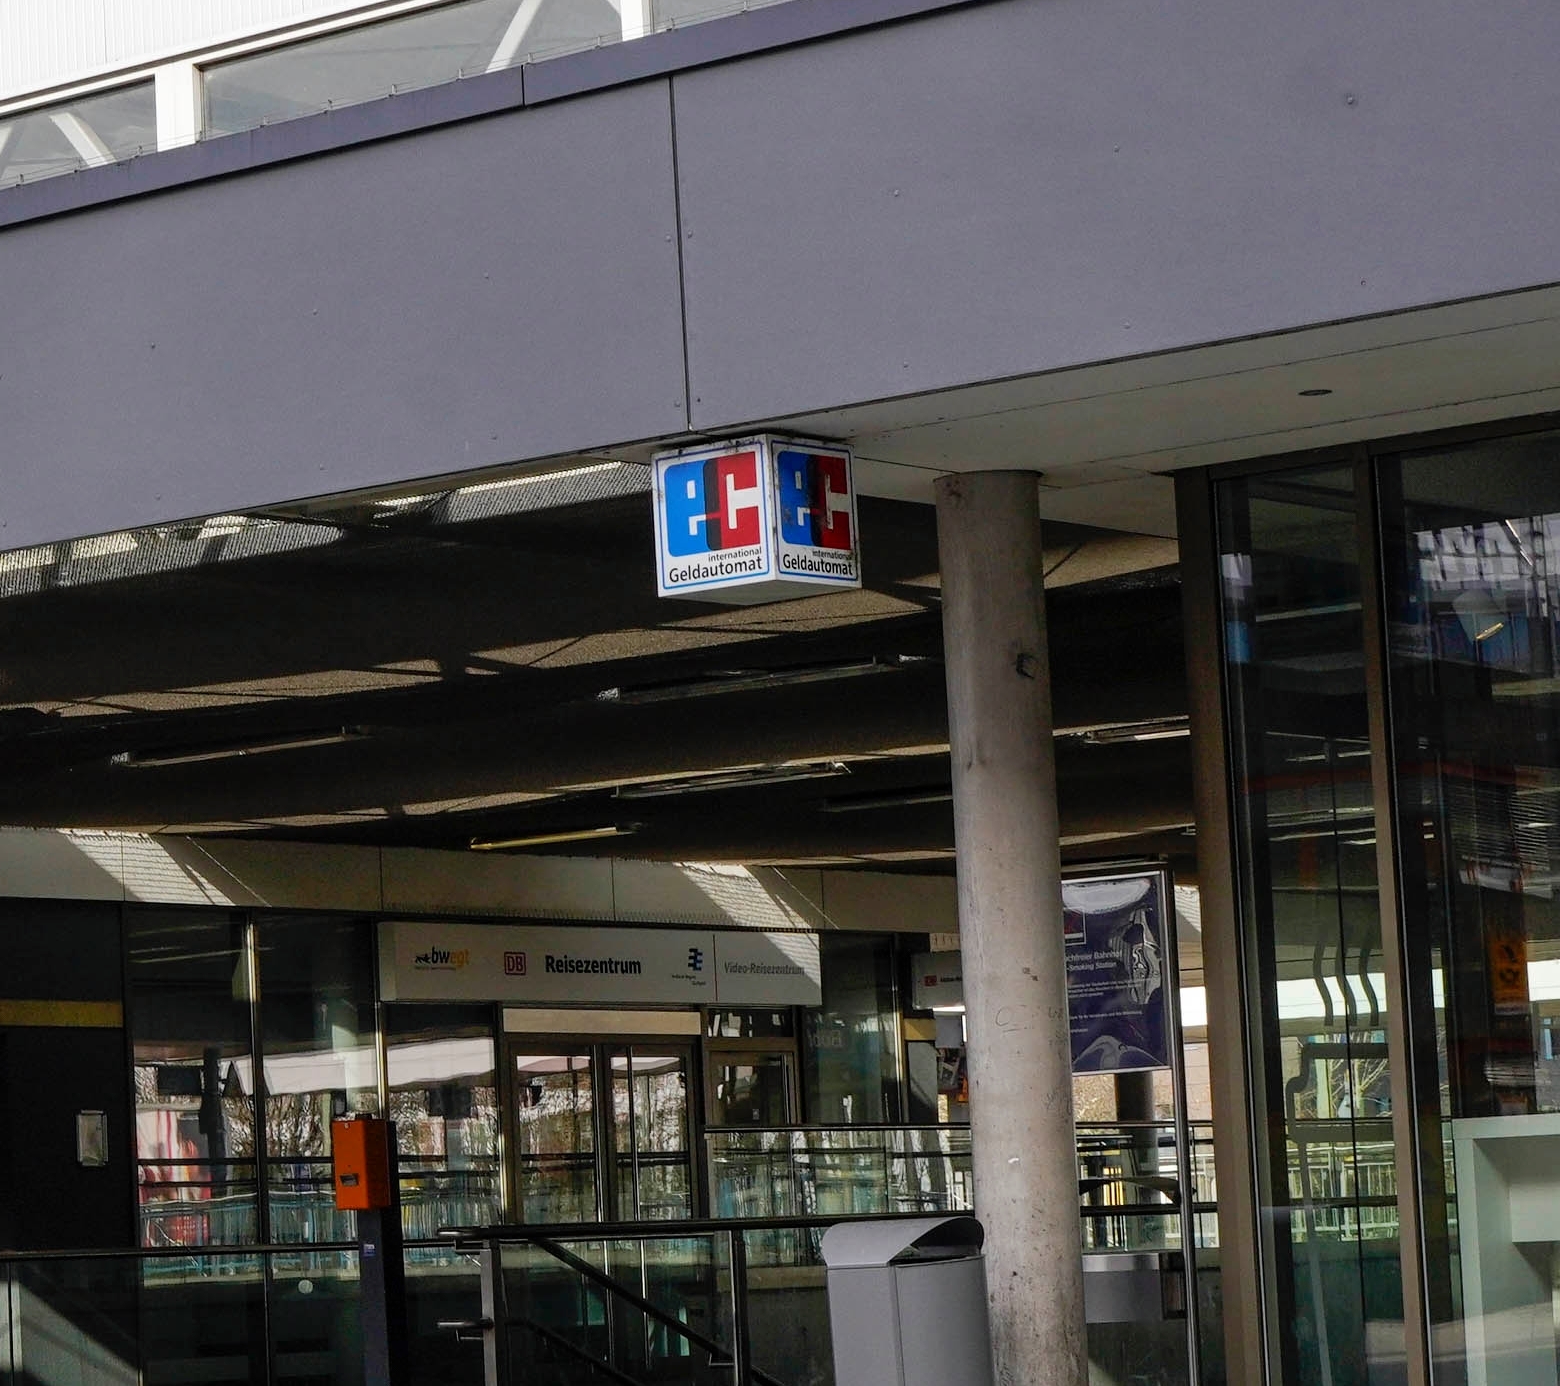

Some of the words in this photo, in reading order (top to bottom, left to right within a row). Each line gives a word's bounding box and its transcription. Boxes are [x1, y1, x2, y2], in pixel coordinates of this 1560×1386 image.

[708, 547, 762, 563] international
[669, 556, 763, 583] Geldautomat
[783, 553, 854, 577] Geldautomat
[506, 953, 525, 972] DB
[545, 955, 642, 975] Reisezentrum
[724, 962, 805, 976] Video-Reisezentrum
[1067, 963, 1095, 973] -Smoking
